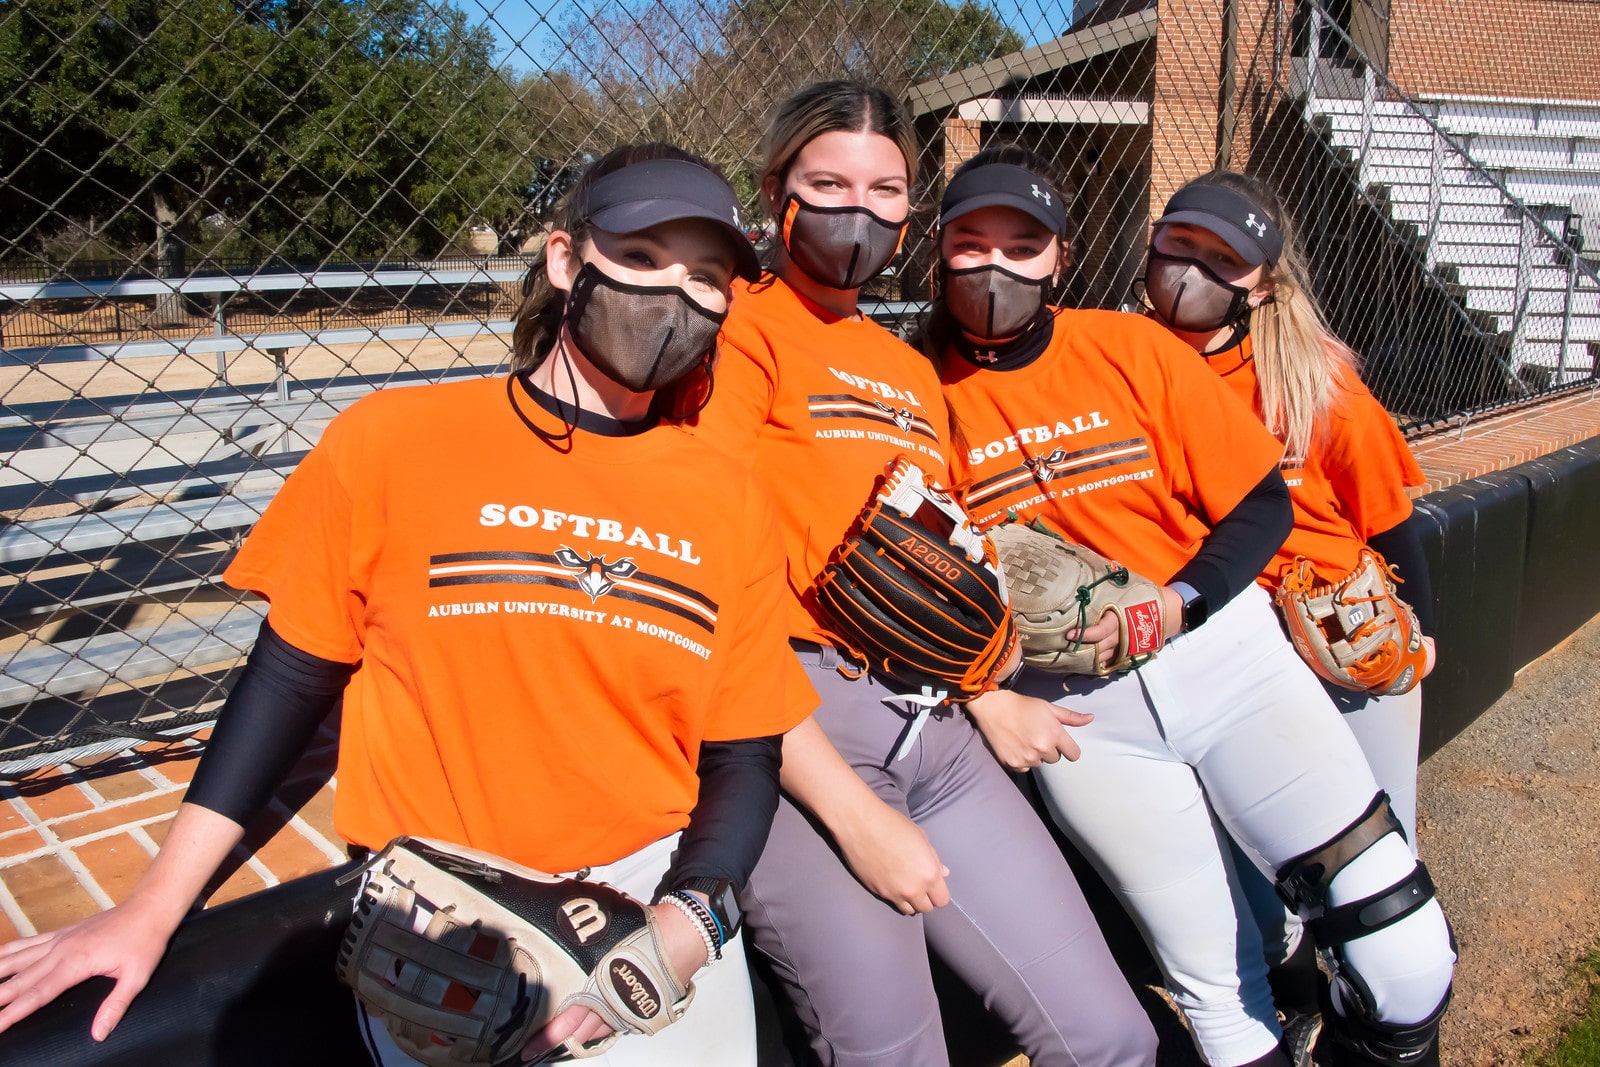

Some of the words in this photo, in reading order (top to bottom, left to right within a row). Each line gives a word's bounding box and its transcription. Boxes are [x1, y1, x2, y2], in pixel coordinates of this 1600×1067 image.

[815, 429, 864, 439] AUBURN
[867, 430, 916, 451] UNIVERSITY
[967, 411, 1109, 466] SOFTBALL
[1061, 488, 1074, 498] AT
[1078, 469, 1155, 494] MONTGOMERY
[479, 503, 701, 566] SOFTBALL
[898, 536, 962, 582] A2000
[428, 601, 499, 618] AUBURN
[504, 601, 608, 624] UNIVERSITY
[611, 614, 633, 629] AT
[636, 620, 712, 661] MONTGOMERY
[1136, 609, 1154, 649] Rawlings
[617, 963, 658, 1018] Wilson
